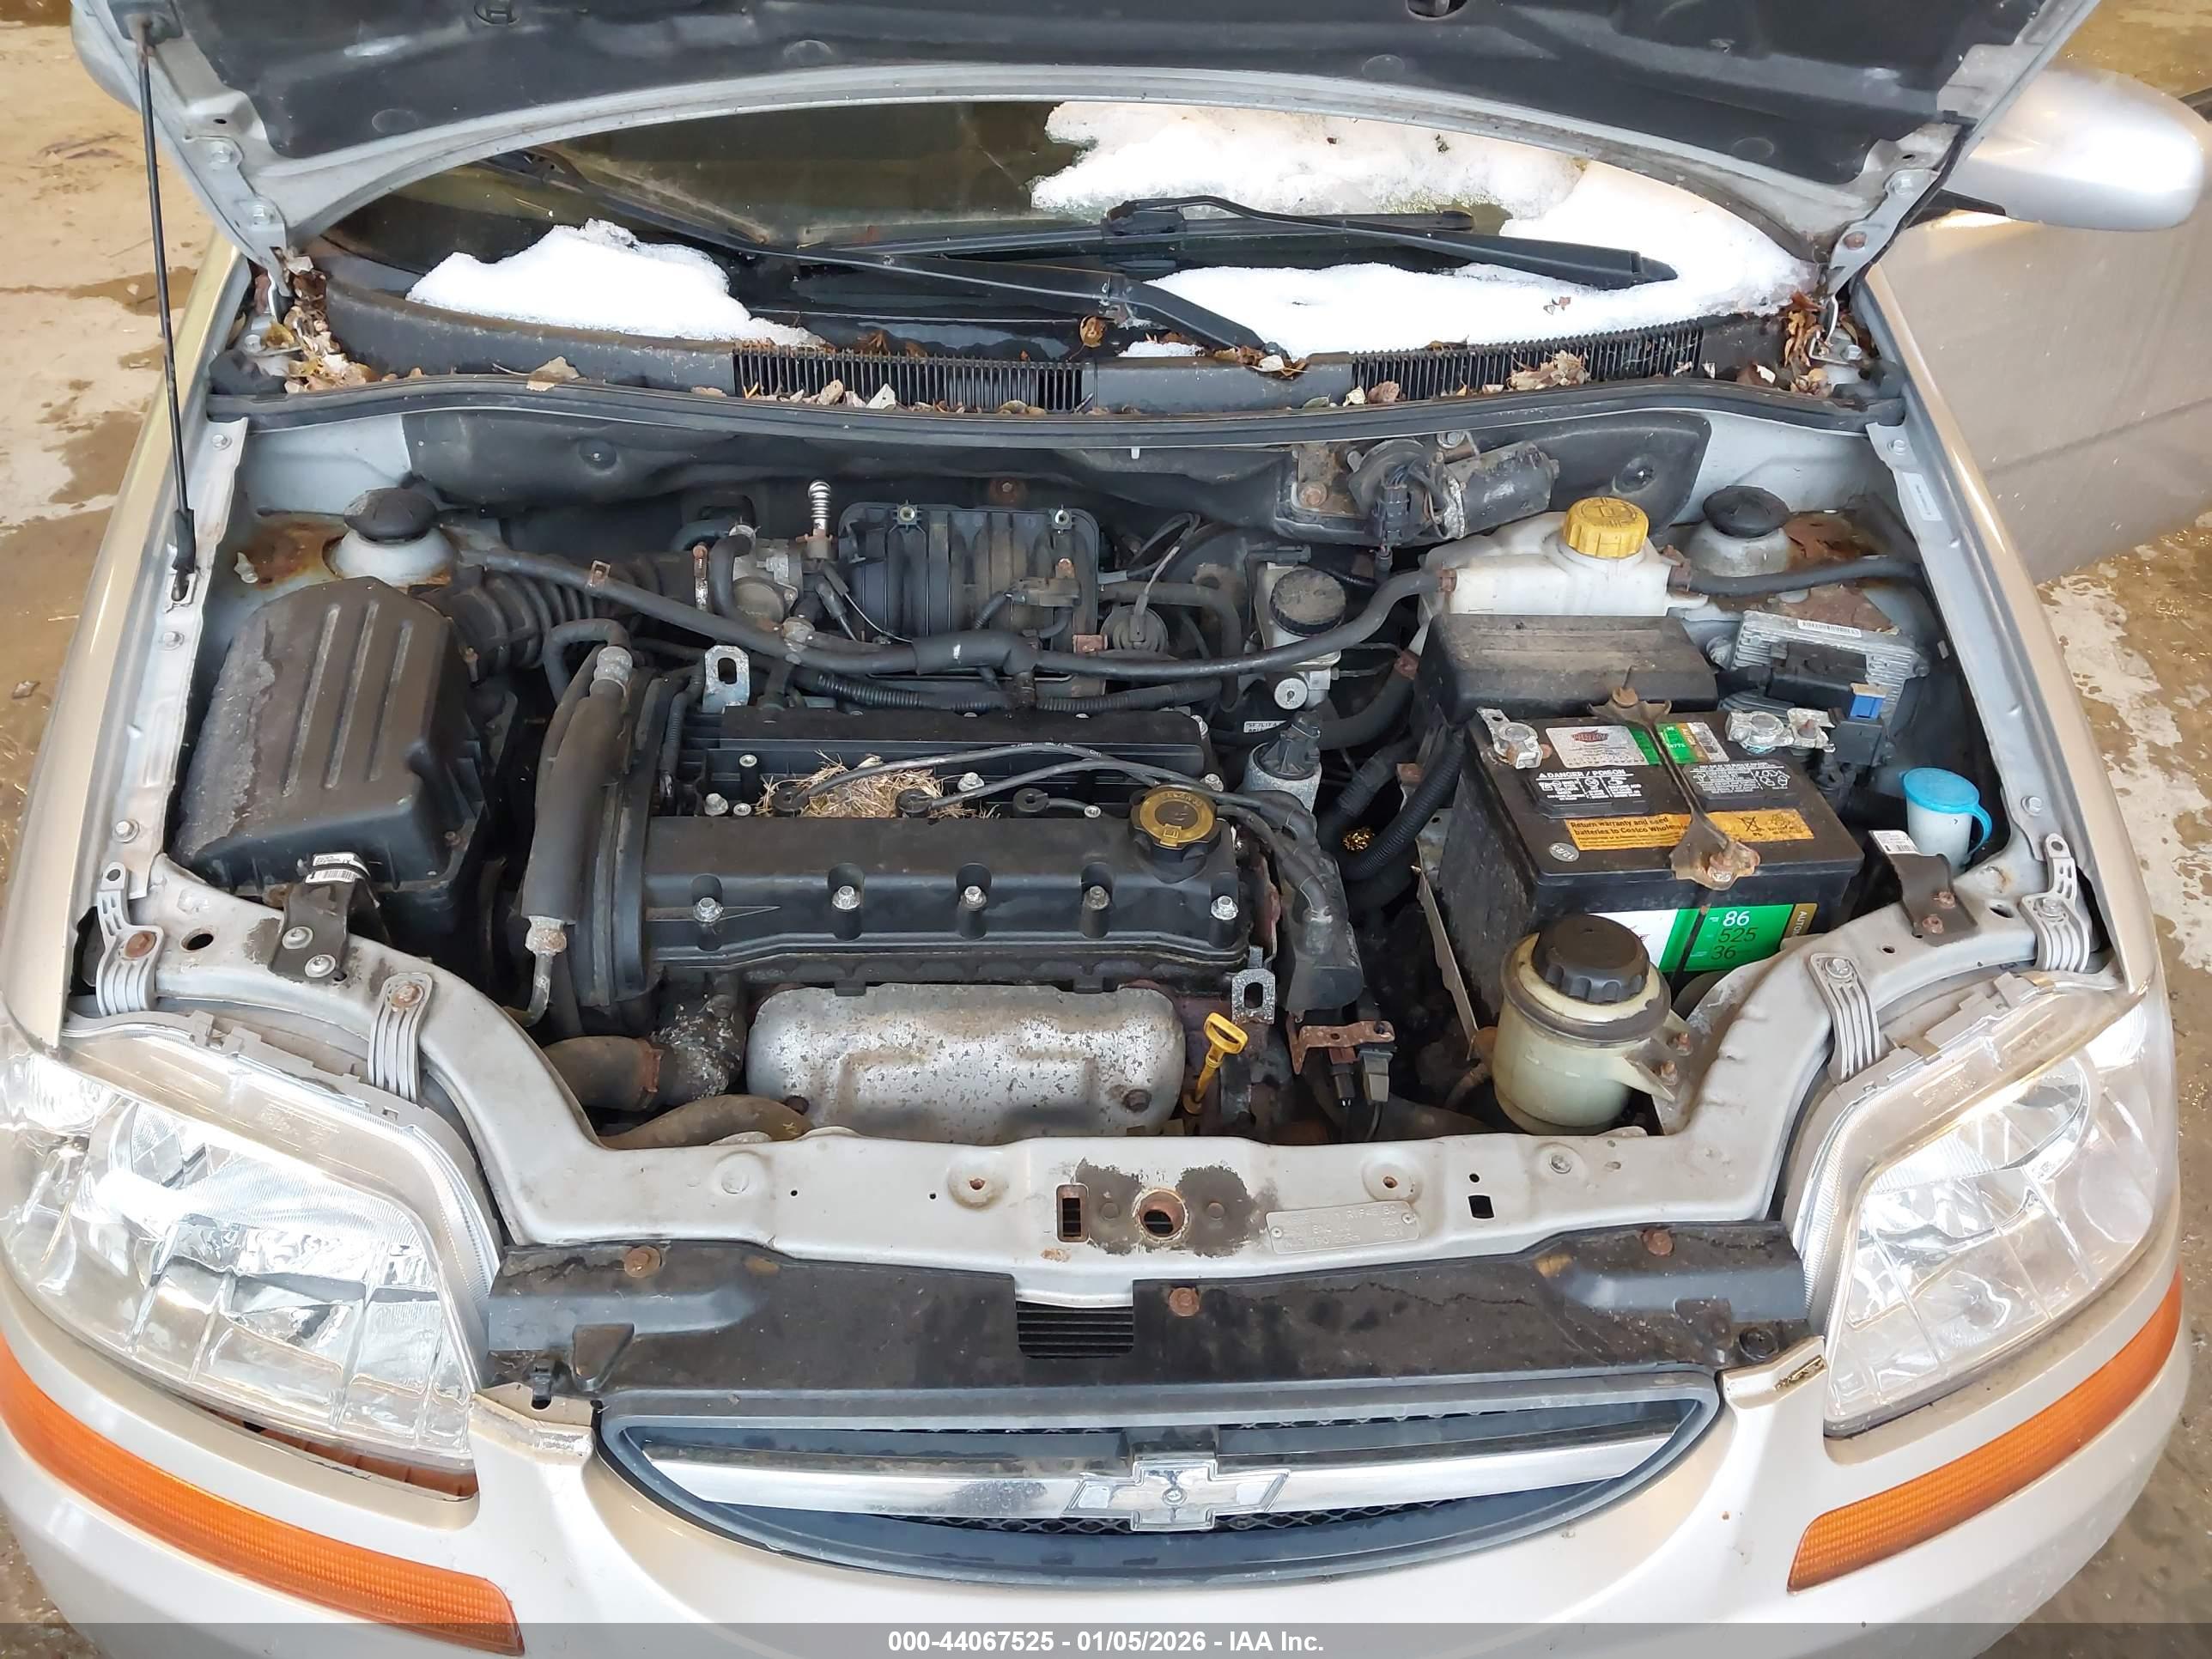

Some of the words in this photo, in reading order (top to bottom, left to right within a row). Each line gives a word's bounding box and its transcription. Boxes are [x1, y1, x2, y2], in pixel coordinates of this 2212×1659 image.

[1723, 910, 1750, 927] 86
[1718, 927, 1759, 943] 525
[1711, 945, 1737, 960] 36
